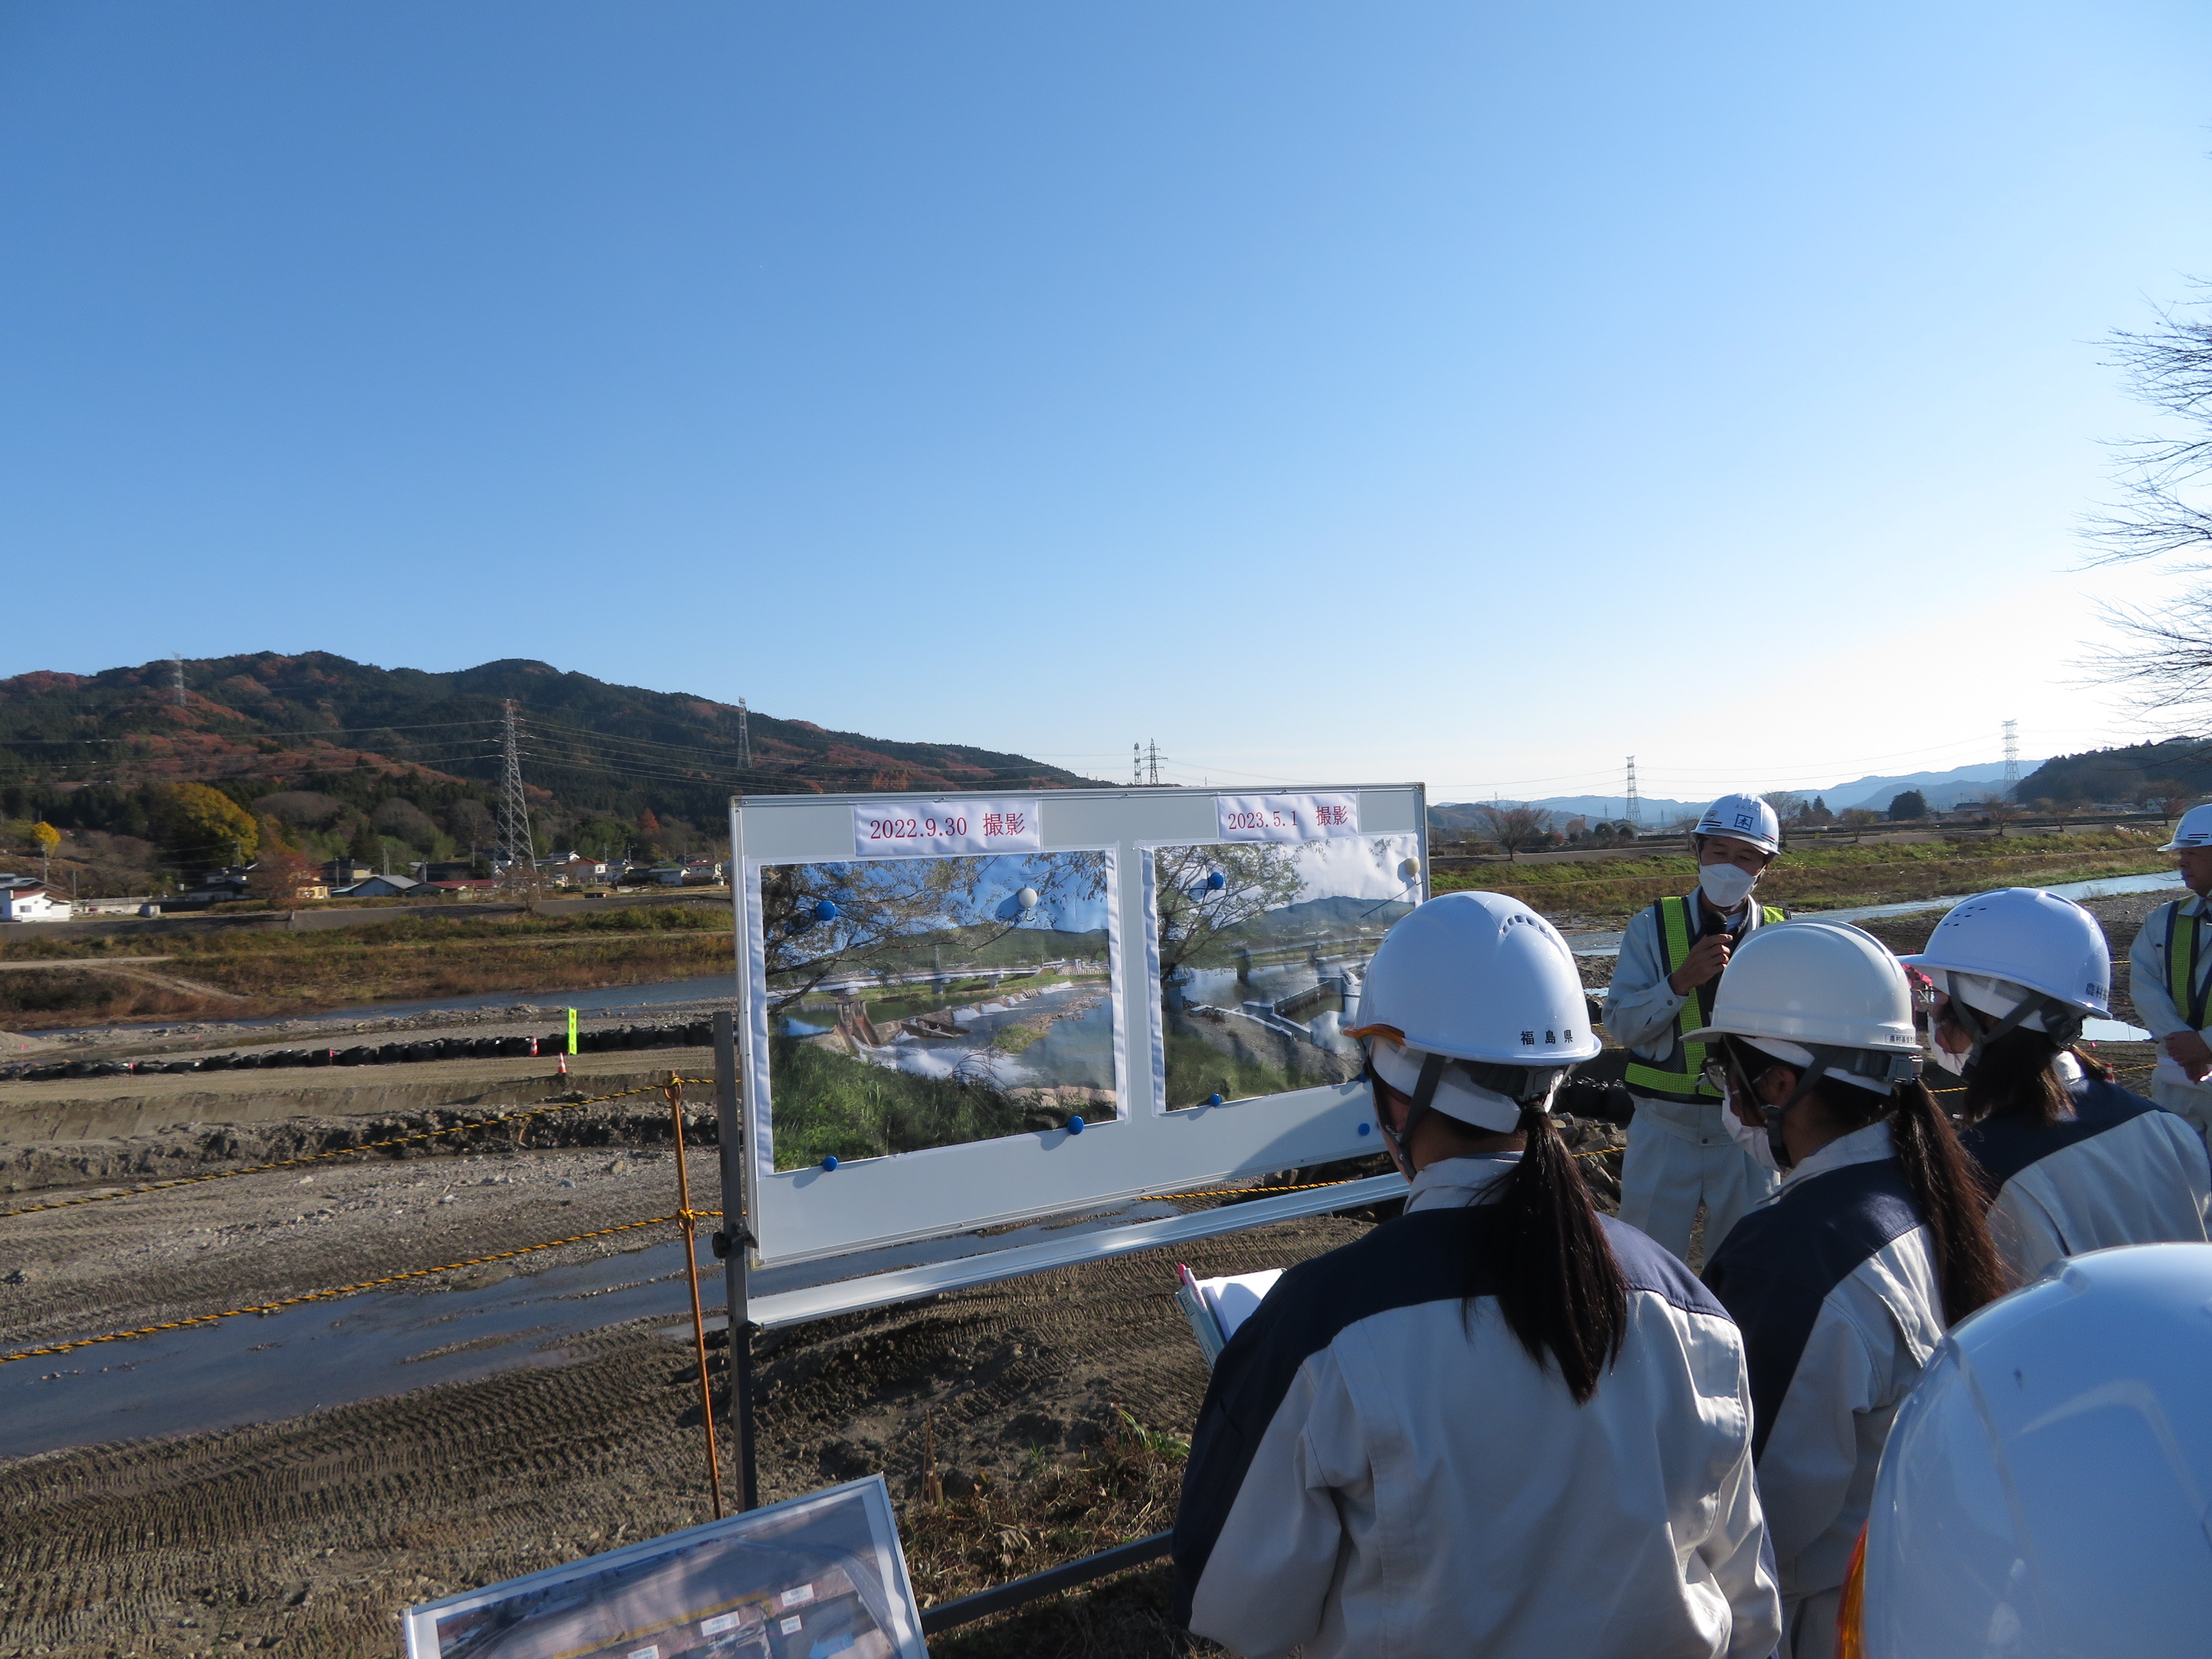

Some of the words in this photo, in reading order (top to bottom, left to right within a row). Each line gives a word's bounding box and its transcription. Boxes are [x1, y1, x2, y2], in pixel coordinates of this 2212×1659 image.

[870, 817, 967, 839] 2022.9.30
[982, 813, 1026, 837] 撮影
[1228, 810, 1298, 830] 2023.5.1
[1315, 805, 1349, 826] 撮影
[1520, 1030, 1574, 1045] 福島県
